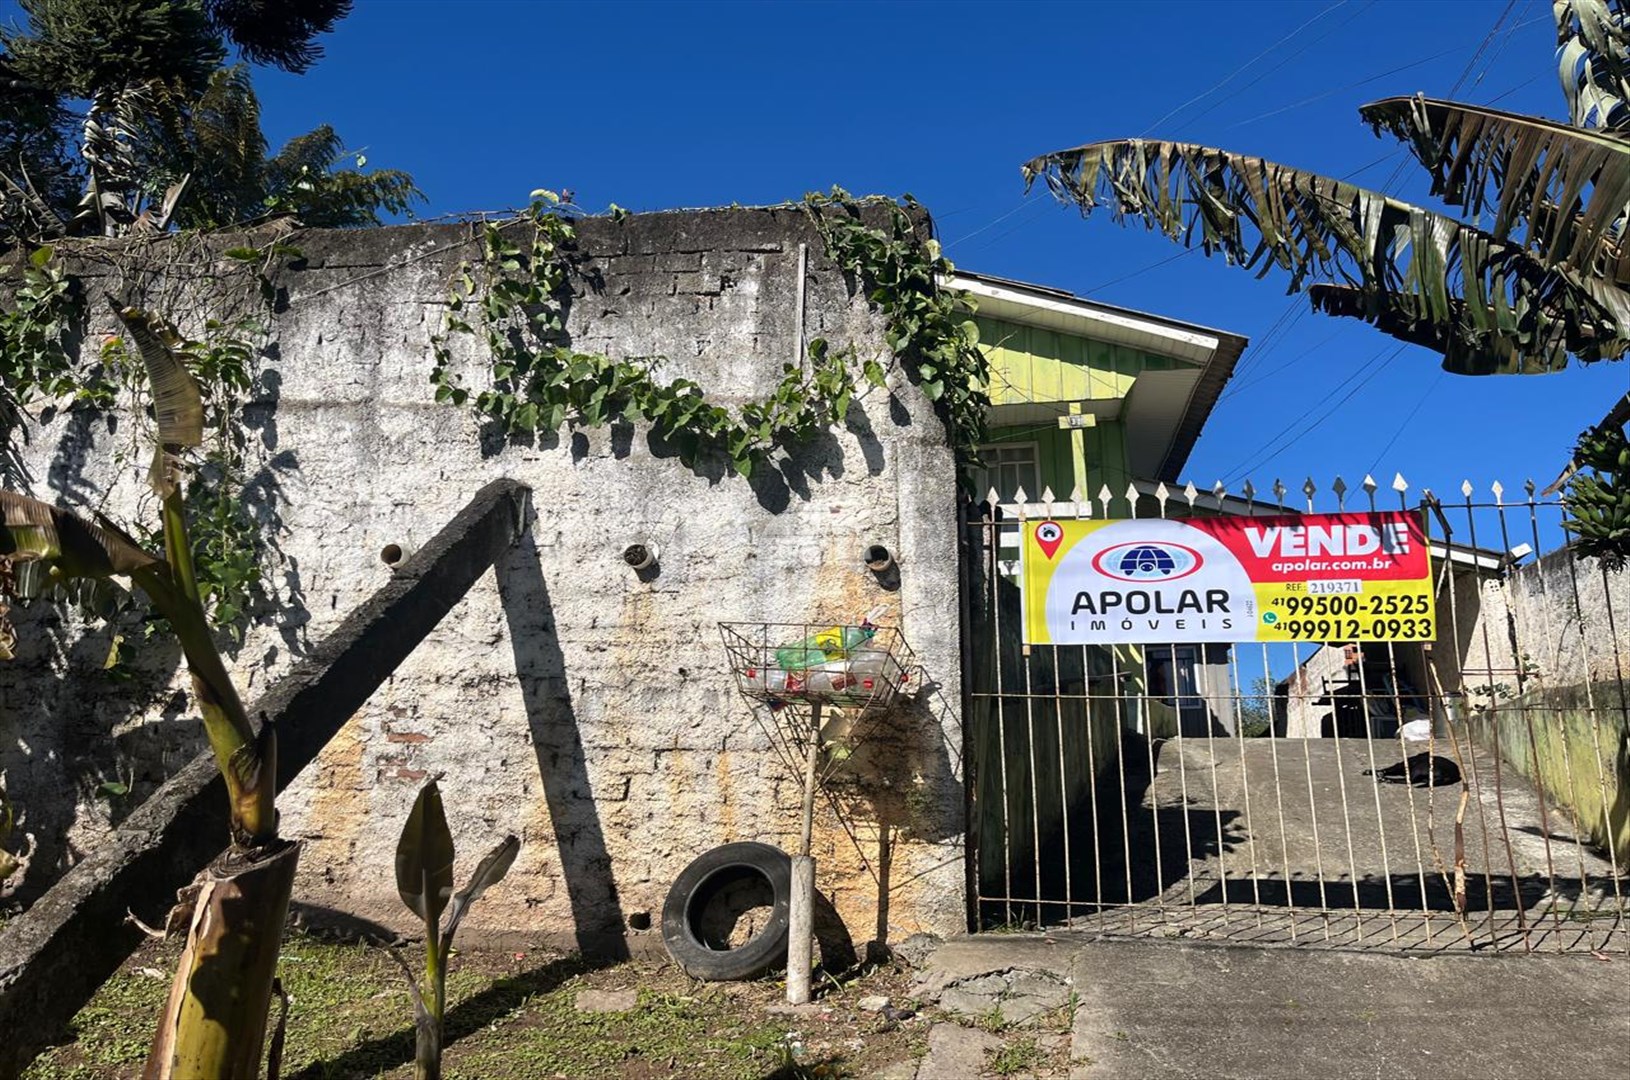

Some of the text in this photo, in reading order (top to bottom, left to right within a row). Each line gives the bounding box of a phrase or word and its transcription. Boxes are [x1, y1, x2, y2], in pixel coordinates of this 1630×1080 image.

[1244, 523, 1409, 558] VENDE
[1271, 558, 1392, 573] apolar.com.br
[1311, 582, 1360, 594] 219371
[1071, 590, 1231, 615] APOLAR
[1071, 618, 1232, 631] IMÓVEIS
